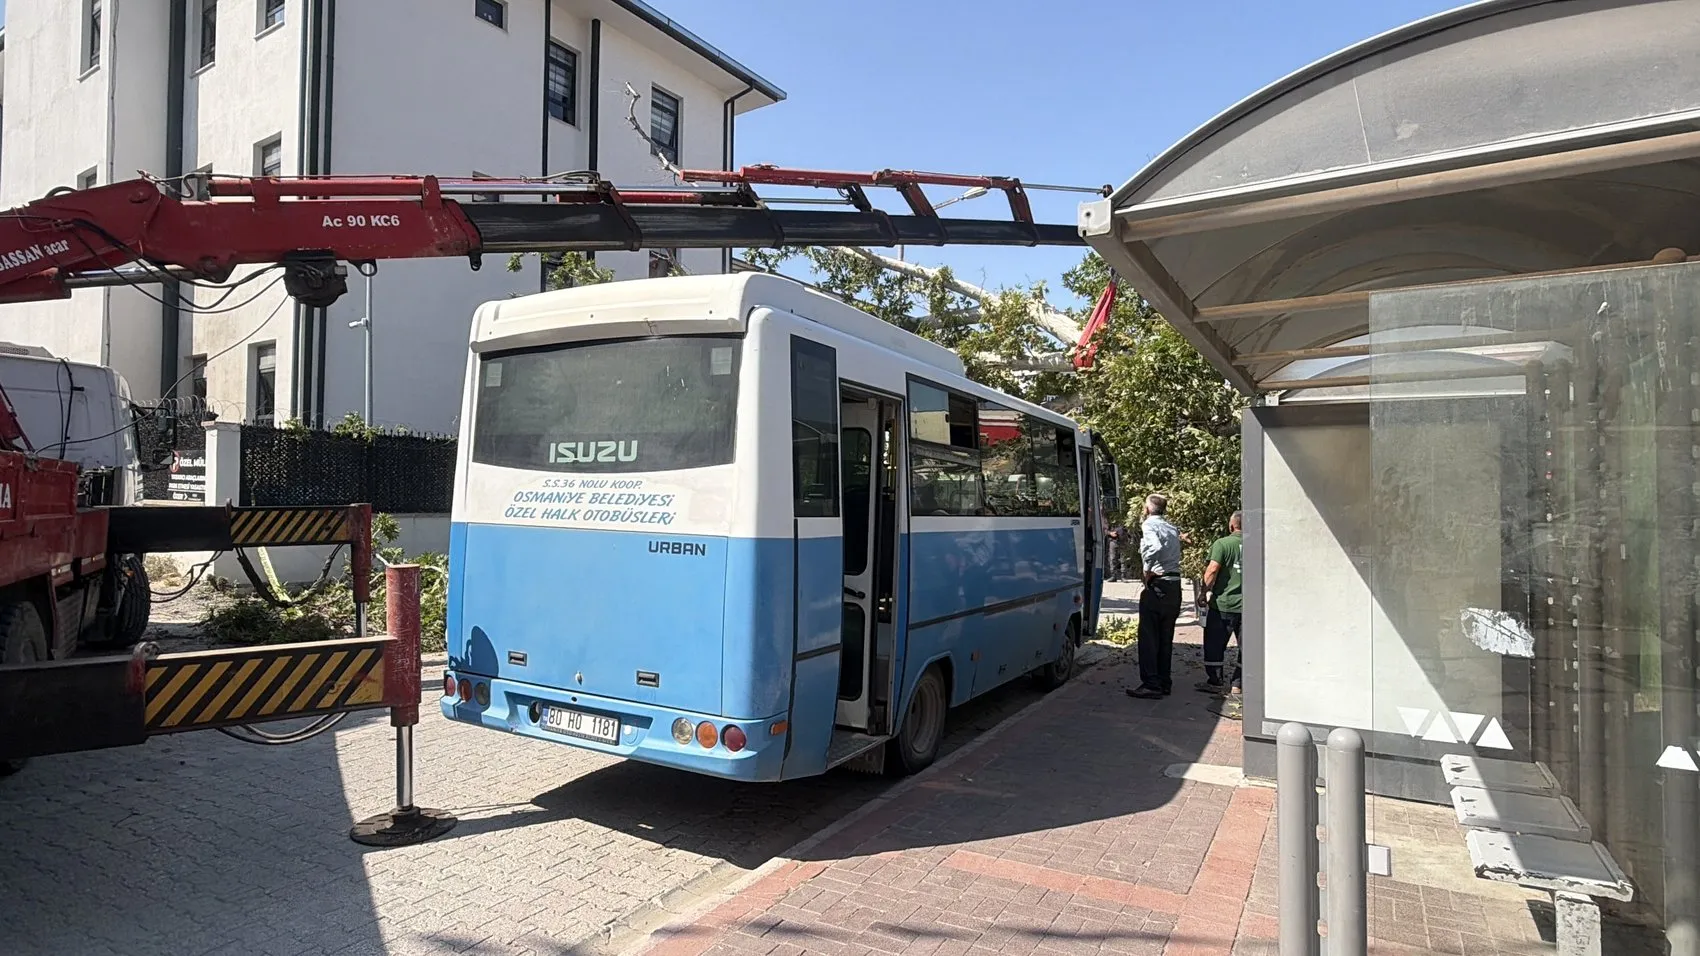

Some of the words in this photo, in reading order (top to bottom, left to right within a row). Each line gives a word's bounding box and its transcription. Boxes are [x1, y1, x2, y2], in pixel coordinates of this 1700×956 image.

[322, 215, 343, 227] Ac
[347, 215, 366, 227] 90
[370, 215, 400, 227] KC6
[44, 240, 70, 255] acar
[549, 440, 638, 463] ISUZU
[579, 479, 609, 489] NOLU
[610, 480, 643, 489] KOOP.
[504, 504, 537, 519] ÖZEL
[540, 507, 581, 520] HALK
[648, 540, 706, 556] URBAN
[548, 708, 562, 726] 80
[593, 716, 615, 738] 1181
